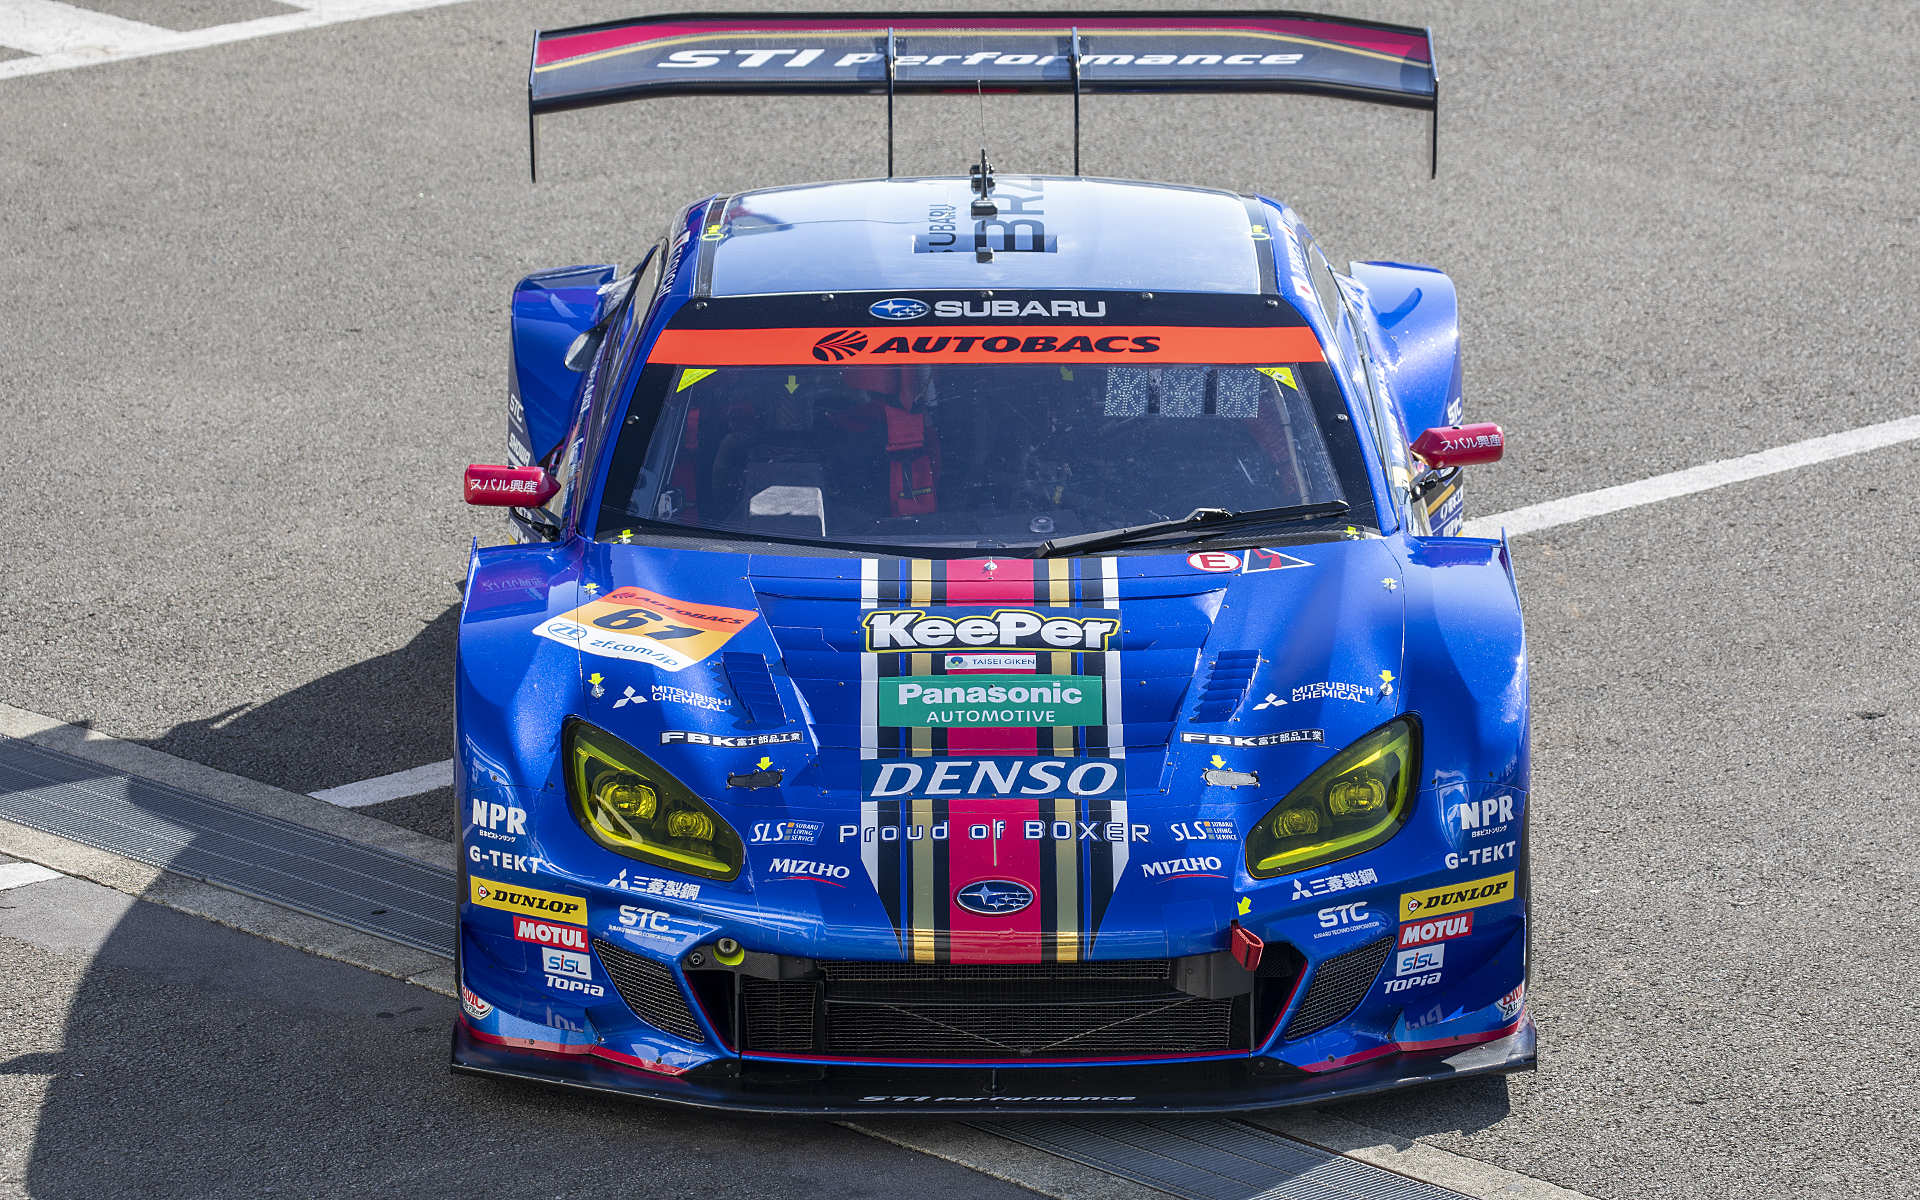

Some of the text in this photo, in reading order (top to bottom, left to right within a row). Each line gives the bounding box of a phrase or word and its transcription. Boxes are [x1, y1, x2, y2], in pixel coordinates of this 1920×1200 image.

[657, 49, 1304, 68] STI Performance
[934, 300, 1106, 317] SUBARU
[870, 335, 1161, 354] AUTOBACS
[509, 393, 524, 423] STC
[1447, 397, 1462, 425] STC
[1440, 434, 1502, 452] スバル興産
[470, 478, 538, 493] スバル興産
[1198, 554, 1230, 569] E
[635, 595, 745, 625] AUTOBACS
[552, 624, 586, 640] ZF
[866, 611, 1116, 650] KeePer
[590, 639, 679, 667] zf.com/jp
[972, 658, 1035, 666] TAISEI GIKEN
[651, 685, 732, 706] MITSUBISHI
[898, 682, 1083, 705] Panasonic
[1292, 682, 1373, 696] MITSUBISHI
[1292, 691, 1366, 703] CHEMICAL
[652, 693, 726, 712] CHEMICAL
[926, 710, 1056, 723] AUTOMOTIVE
[661, 732, 737, 746] FBK
[1183, 732, 1257, 747] FBK
[870, 760, 1118, 797] DENSO
[472, 799, 526, 836] NPR
[1460, 795, 1514, 830] NPR
[751, 823, 786, 842] SLS
[838, 820, 1151, 842] Proud of BOXER
[1170, 821, 1207, 841] SLS
[470, 845, 543, 874] G-TEKT
[1444, 841, 1516, 870] G-TEKT
[769, 858, 850, 879] MIZUHO
[1141, 856, 1222, 878] MIZUHO
[629, 875, 700, 901] 三菱製鋼
[1309, 868, 1378, 896] 三菱製鋼
[493, 889, 579, 915] DUNLOP
[1424, 881, 1508, 909] DUNLOP
[619, 904, 670, 932] STC
[1318, 901, 1369, 928] STC
[518, 921, 585, 949] MOTUL
[1401, 917, 1469, 945] MOTUL
